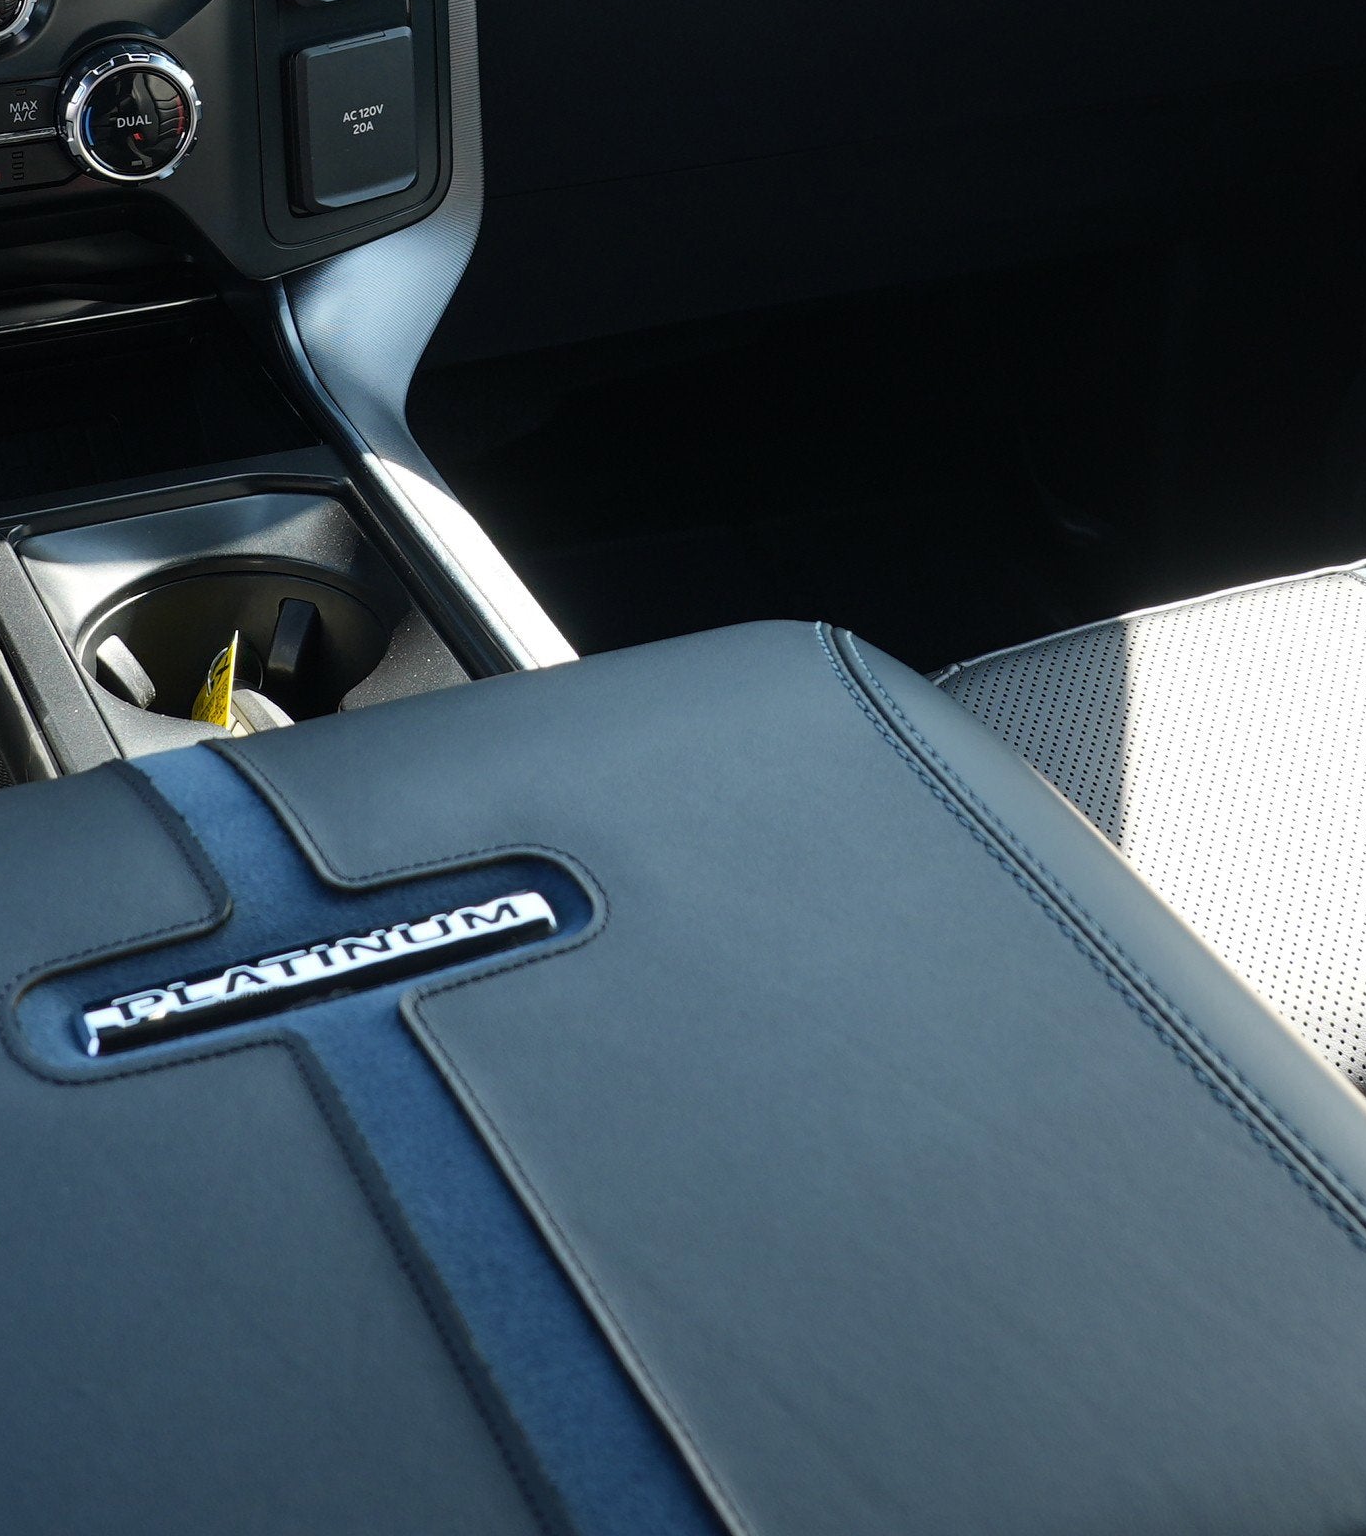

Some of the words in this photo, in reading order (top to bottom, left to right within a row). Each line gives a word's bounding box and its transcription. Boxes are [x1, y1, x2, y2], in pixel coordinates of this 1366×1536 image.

[9, 100, 38, 113] MAX
[13, 110, 37, 123] A/C
[342, 110, 357, 123] AC
[358, 104, 384, 119] 120V
[117, 115, 152, 128] DUAL
[352, 122, 374, 135] 20A
[110, 896, 525, 1026] PLATINUM
